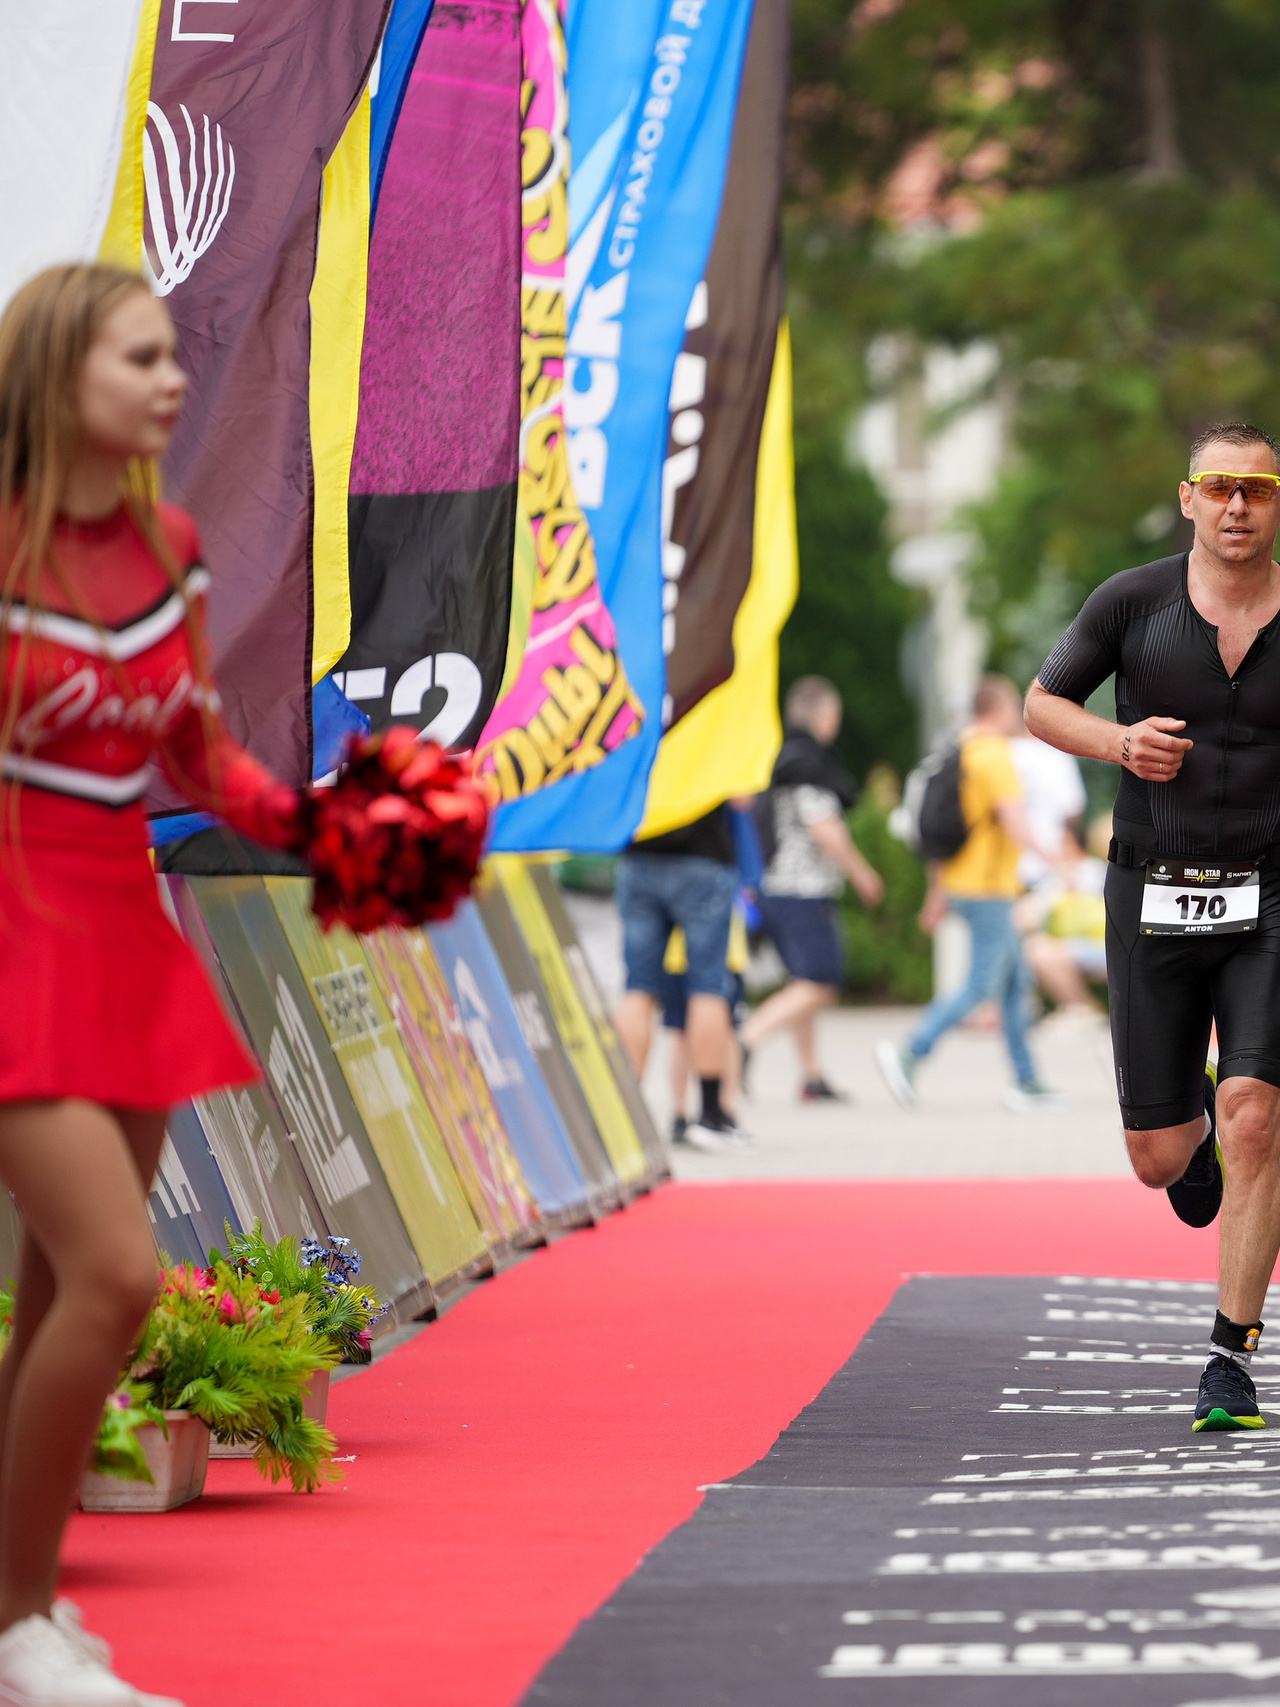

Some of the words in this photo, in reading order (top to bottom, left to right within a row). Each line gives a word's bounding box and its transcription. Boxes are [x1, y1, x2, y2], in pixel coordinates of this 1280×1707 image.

[608, 33, 692, 269] СТРАХОВОЙ
[1184, 868, 1199, 877] IRON
[1205, 869, 1221, 877] STAR
[1175, 894, 1227, 921] 170
[950, 1460, 1265, 1480] IRON
[928, 1482, 1260, 1503] IRON
[886, 1544, 1261, 1567] IRON
[833, 1641, 1260, 1666] IRON
